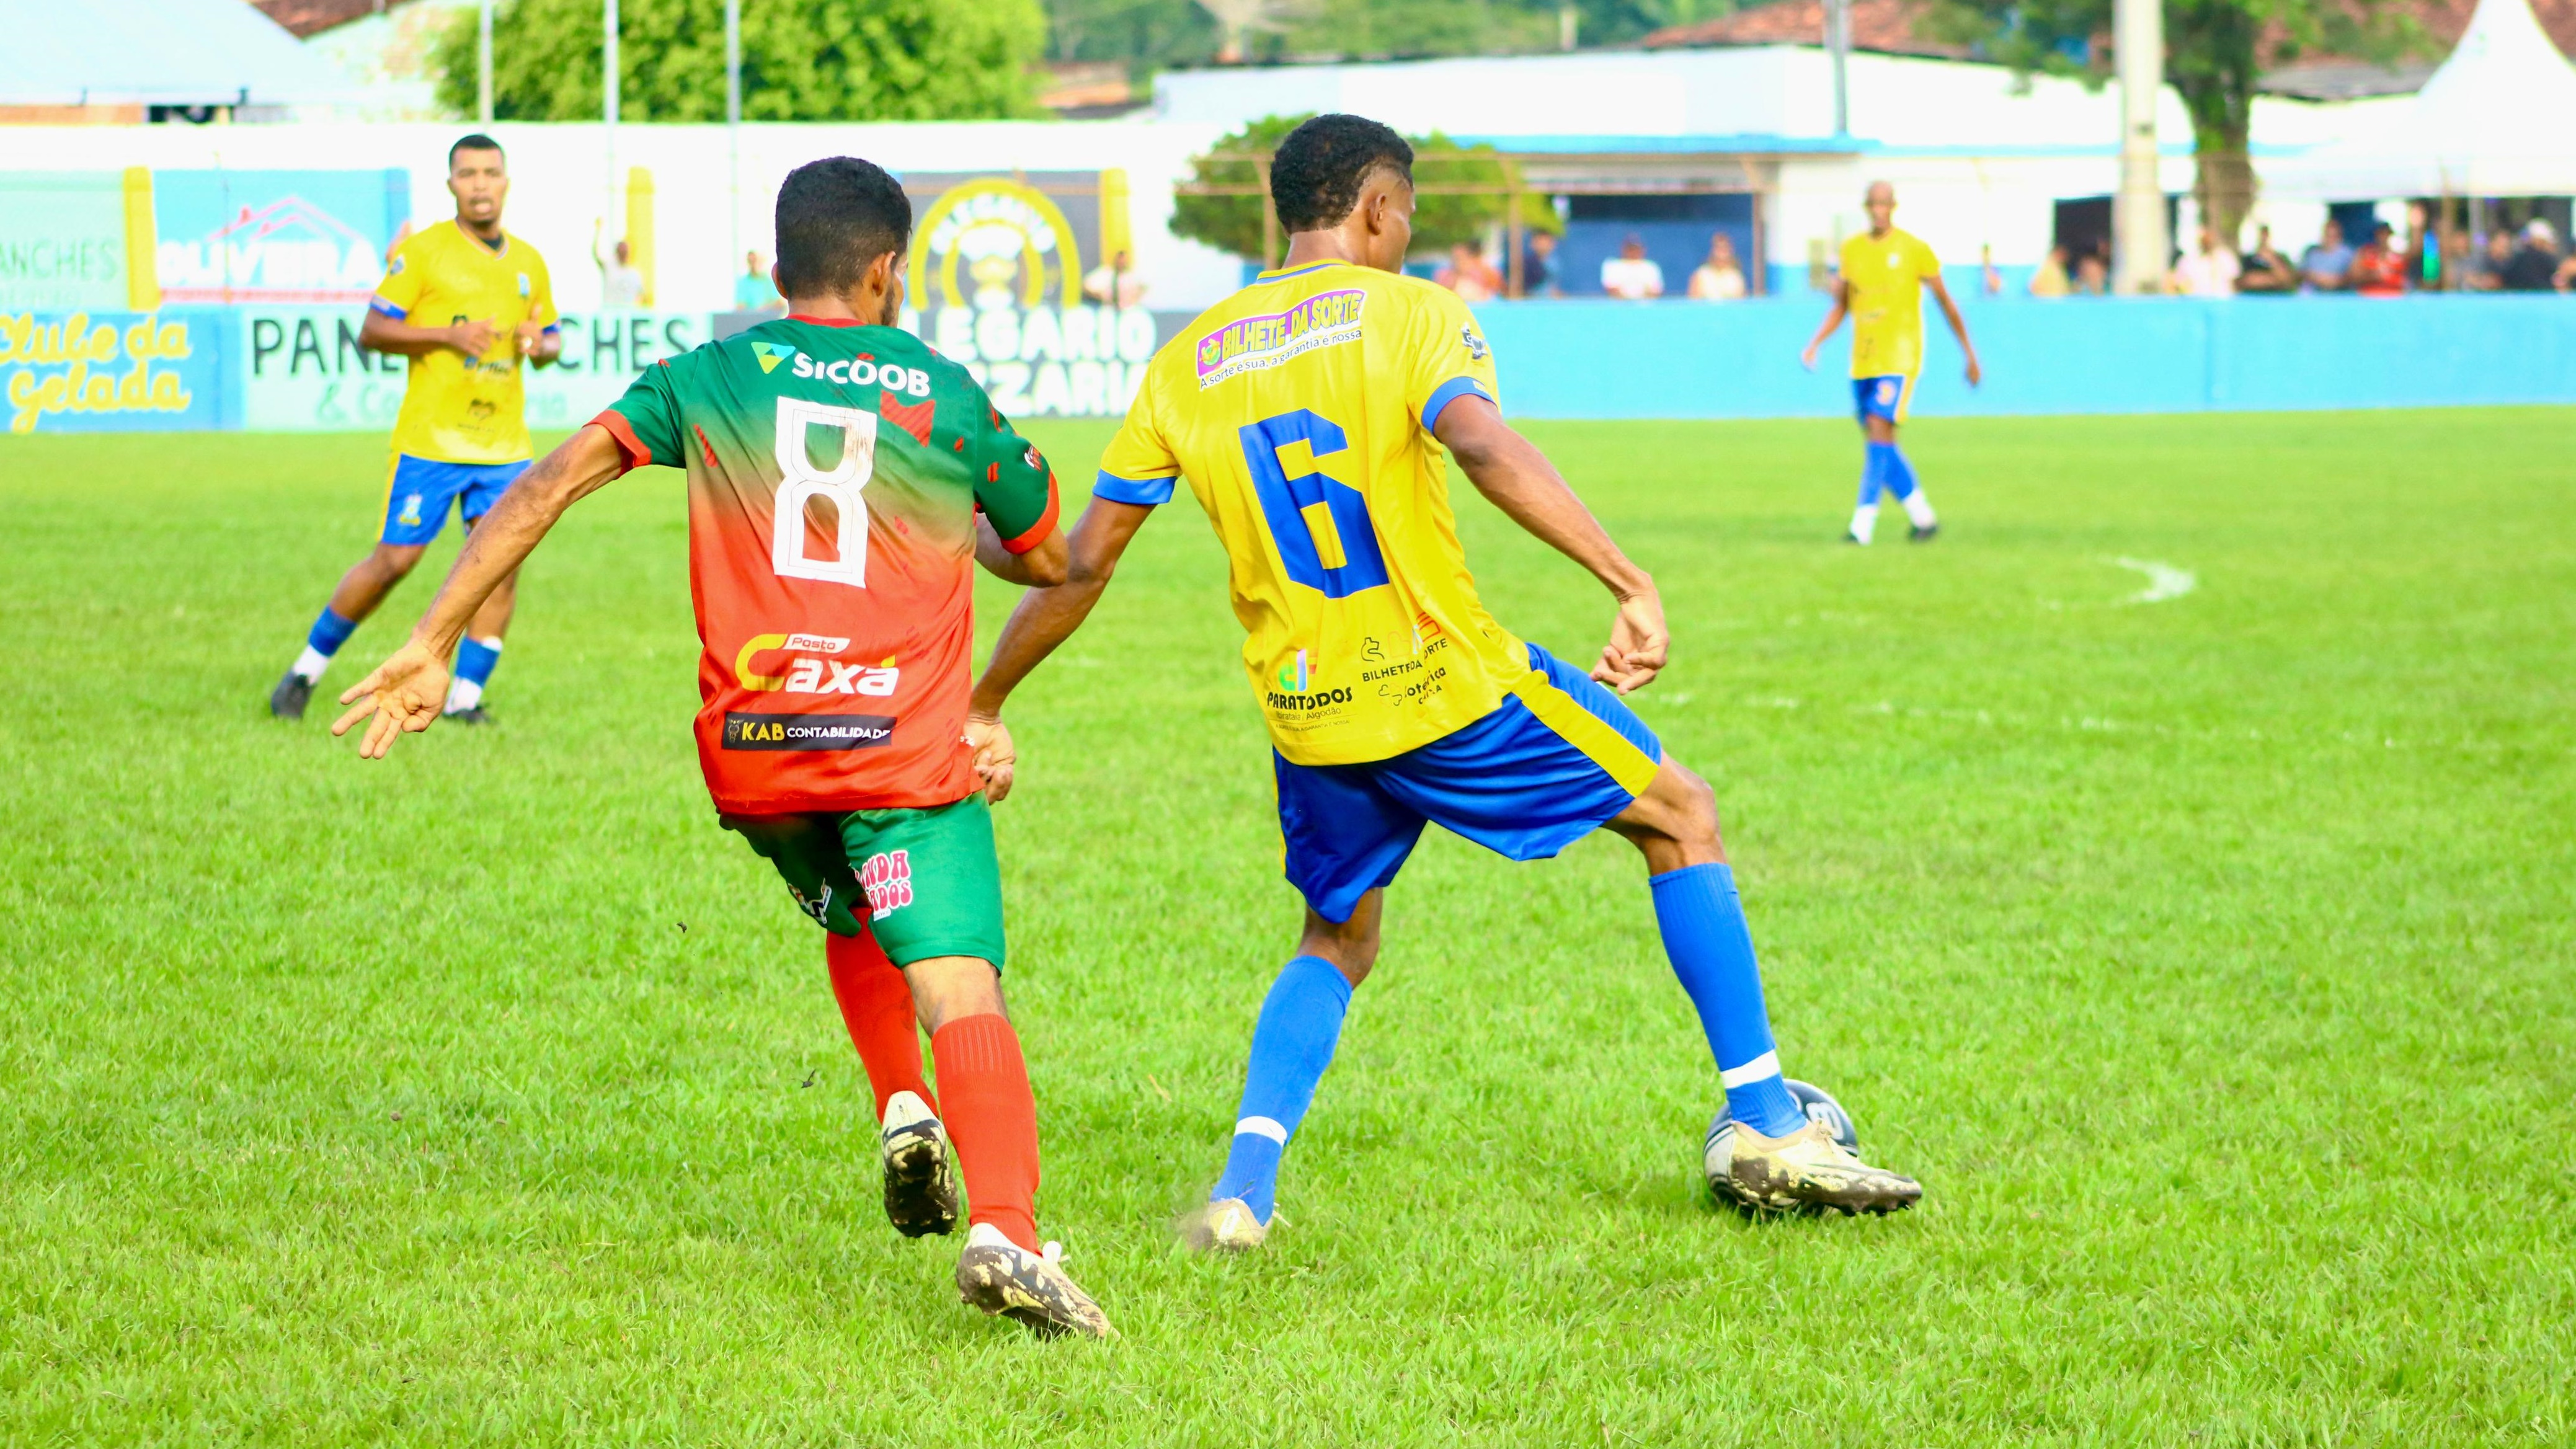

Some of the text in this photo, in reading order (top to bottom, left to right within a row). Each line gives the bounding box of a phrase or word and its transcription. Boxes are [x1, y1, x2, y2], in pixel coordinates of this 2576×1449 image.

[126, 312, 193, 360] da
[1222, 292, 1364, 361] BILHETE DA SORTE
[1199, 378, 1208, 389] A
[1209, 366, 1235, 384] sorte
[1245, 358, 1269, 370] sua,
[1271, 357, 1277, 366] a
[1279, 339, 1320, 364] garantia
[1331, 330, 1362, 345] nossa
[771, 395, 878, 590] 8
[1237, 407, 1390, 599] 6
[791, 637, 836, 650] Posto
[1267, 686, 1353, 711] PARATODOS
[1306, 707, 1341, 721] Algodão
[741, 722, 785, 742] KAB
